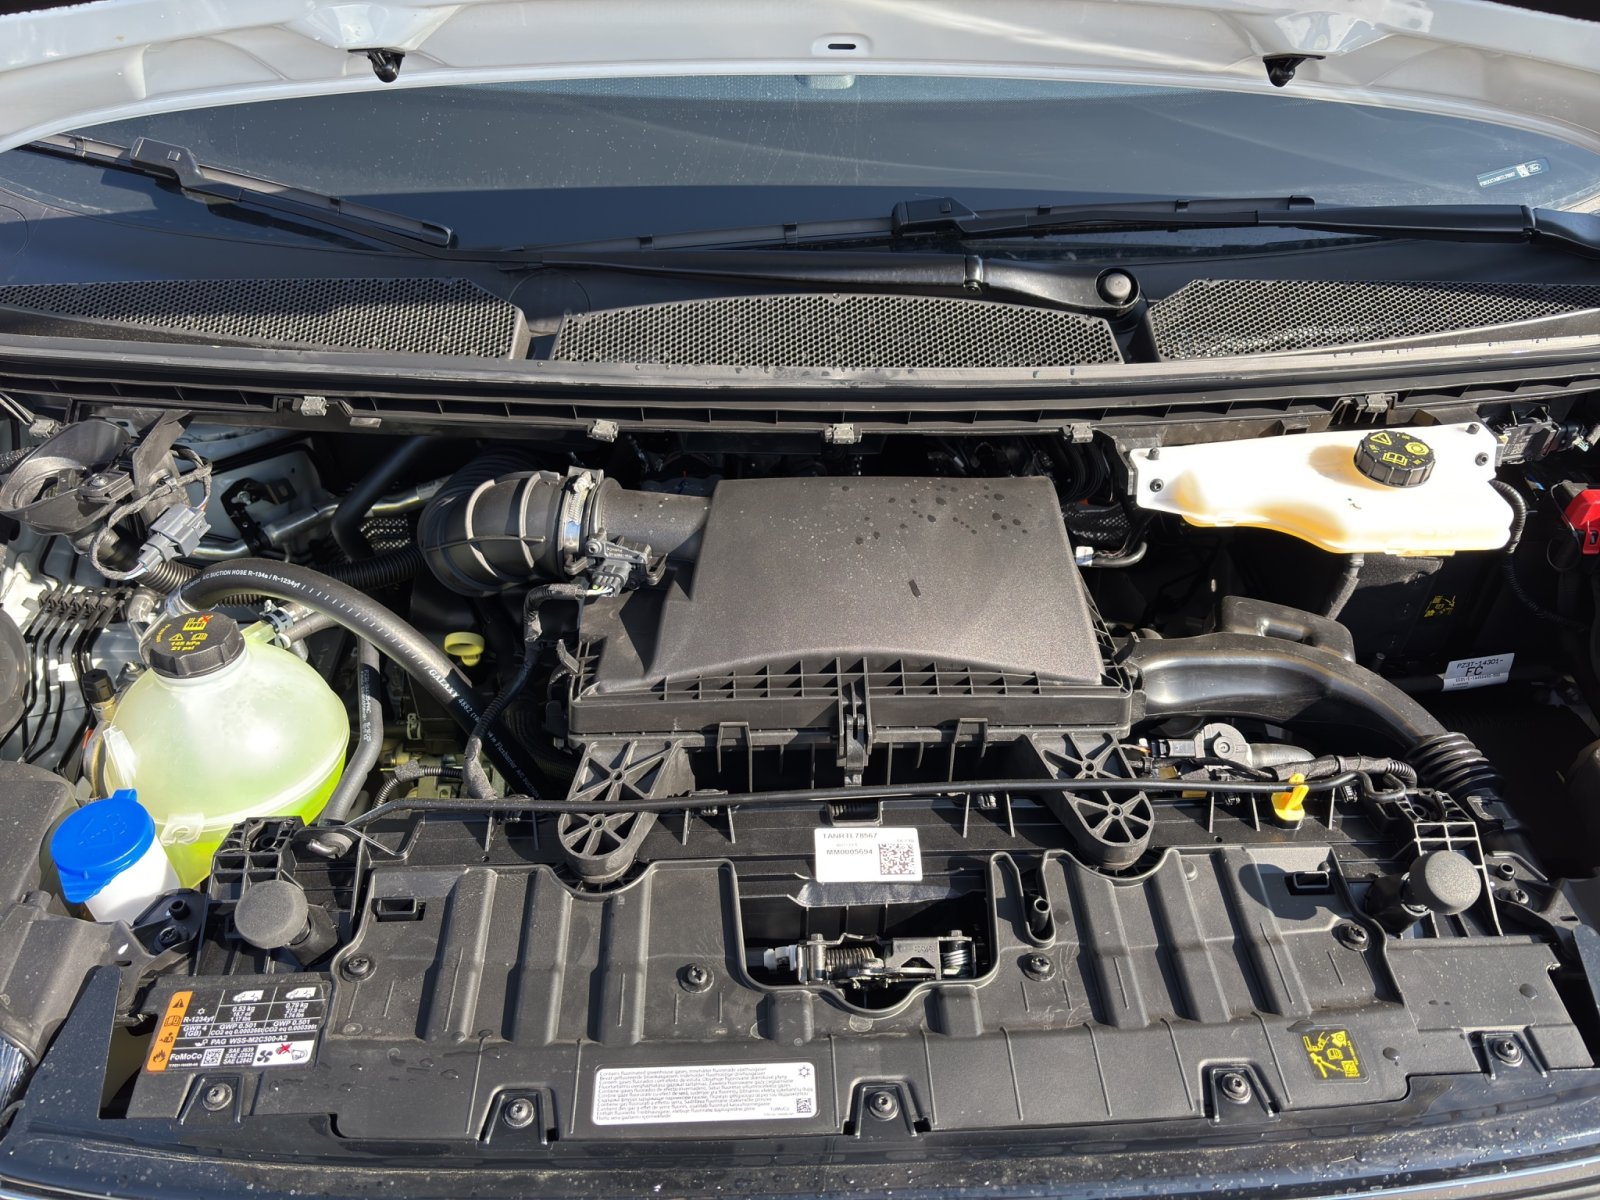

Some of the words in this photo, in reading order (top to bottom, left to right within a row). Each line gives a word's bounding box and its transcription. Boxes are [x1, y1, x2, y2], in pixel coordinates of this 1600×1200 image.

[210, 569, 231, 579] SUCTION
[429, 669, 459, 698] GALAXY
[183, 1015, 214, 1024] R-1234yf
[170, 1052, 202, 1061] FoMoCo
